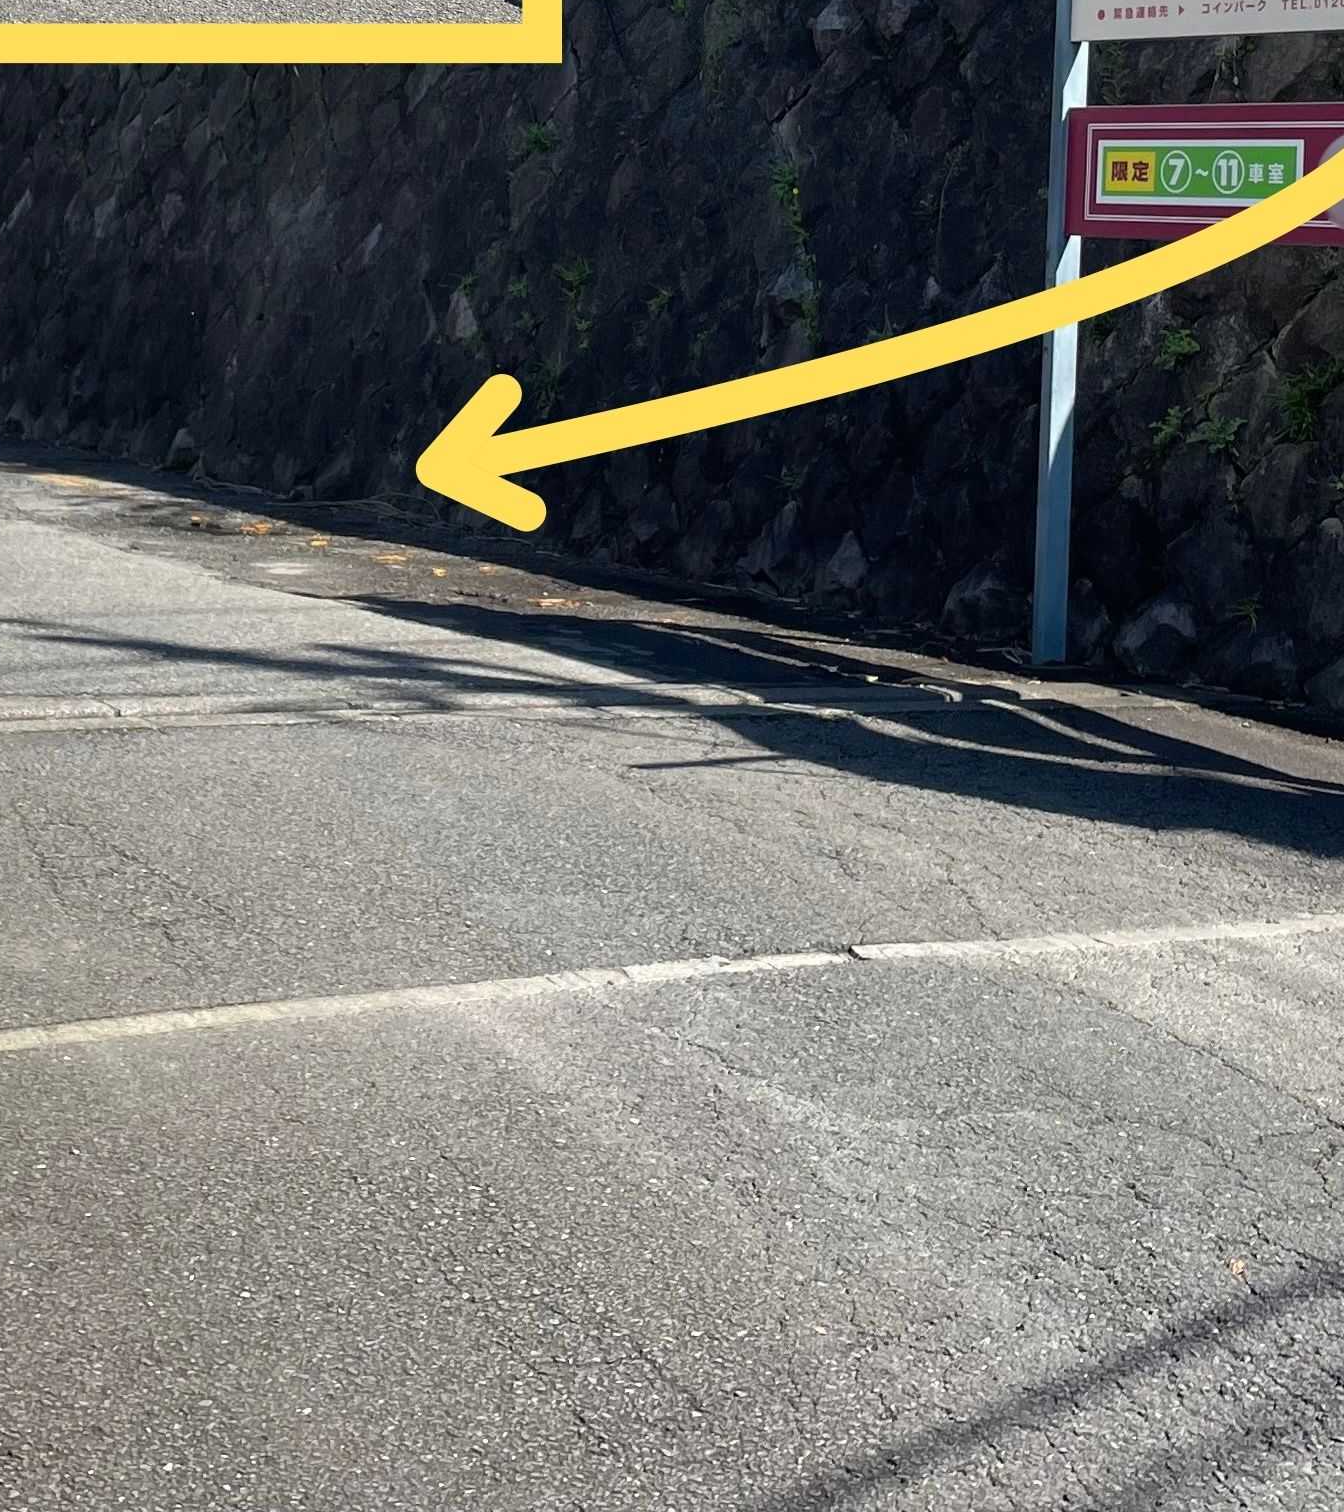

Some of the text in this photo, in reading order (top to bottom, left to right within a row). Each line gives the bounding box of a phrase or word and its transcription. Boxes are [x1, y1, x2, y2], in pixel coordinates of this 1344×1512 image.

[1201, 0, 1267, 14] コインパーク
[1111, 160, 1150, 183] 限定
